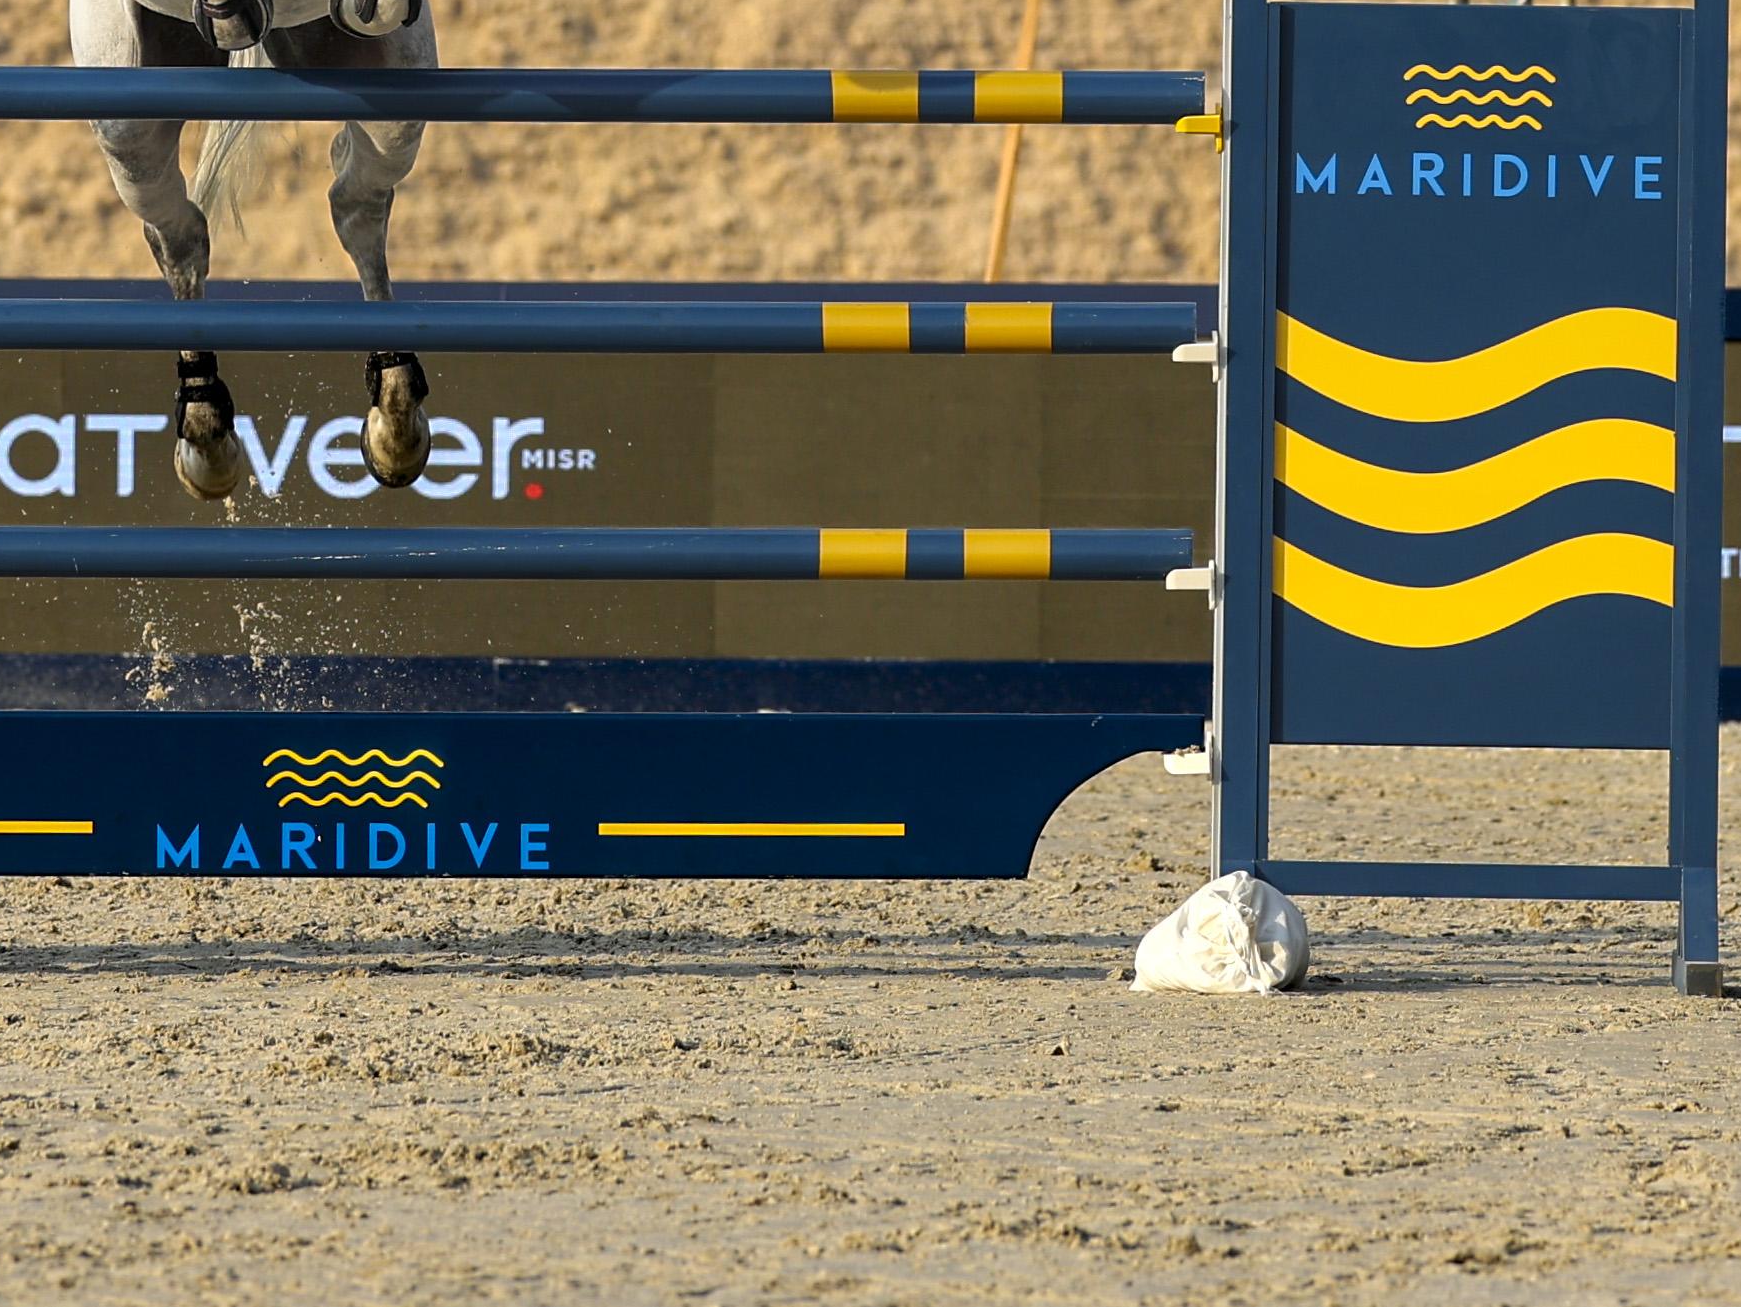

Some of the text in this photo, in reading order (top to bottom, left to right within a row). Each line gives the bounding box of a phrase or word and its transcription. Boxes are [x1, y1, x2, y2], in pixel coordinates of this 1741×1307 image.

[1295, 153, 1663, 199] MARIDIVE
[521, 448, 597, 470] MISR
[156, 822, 551, 870] MARIDIVE
